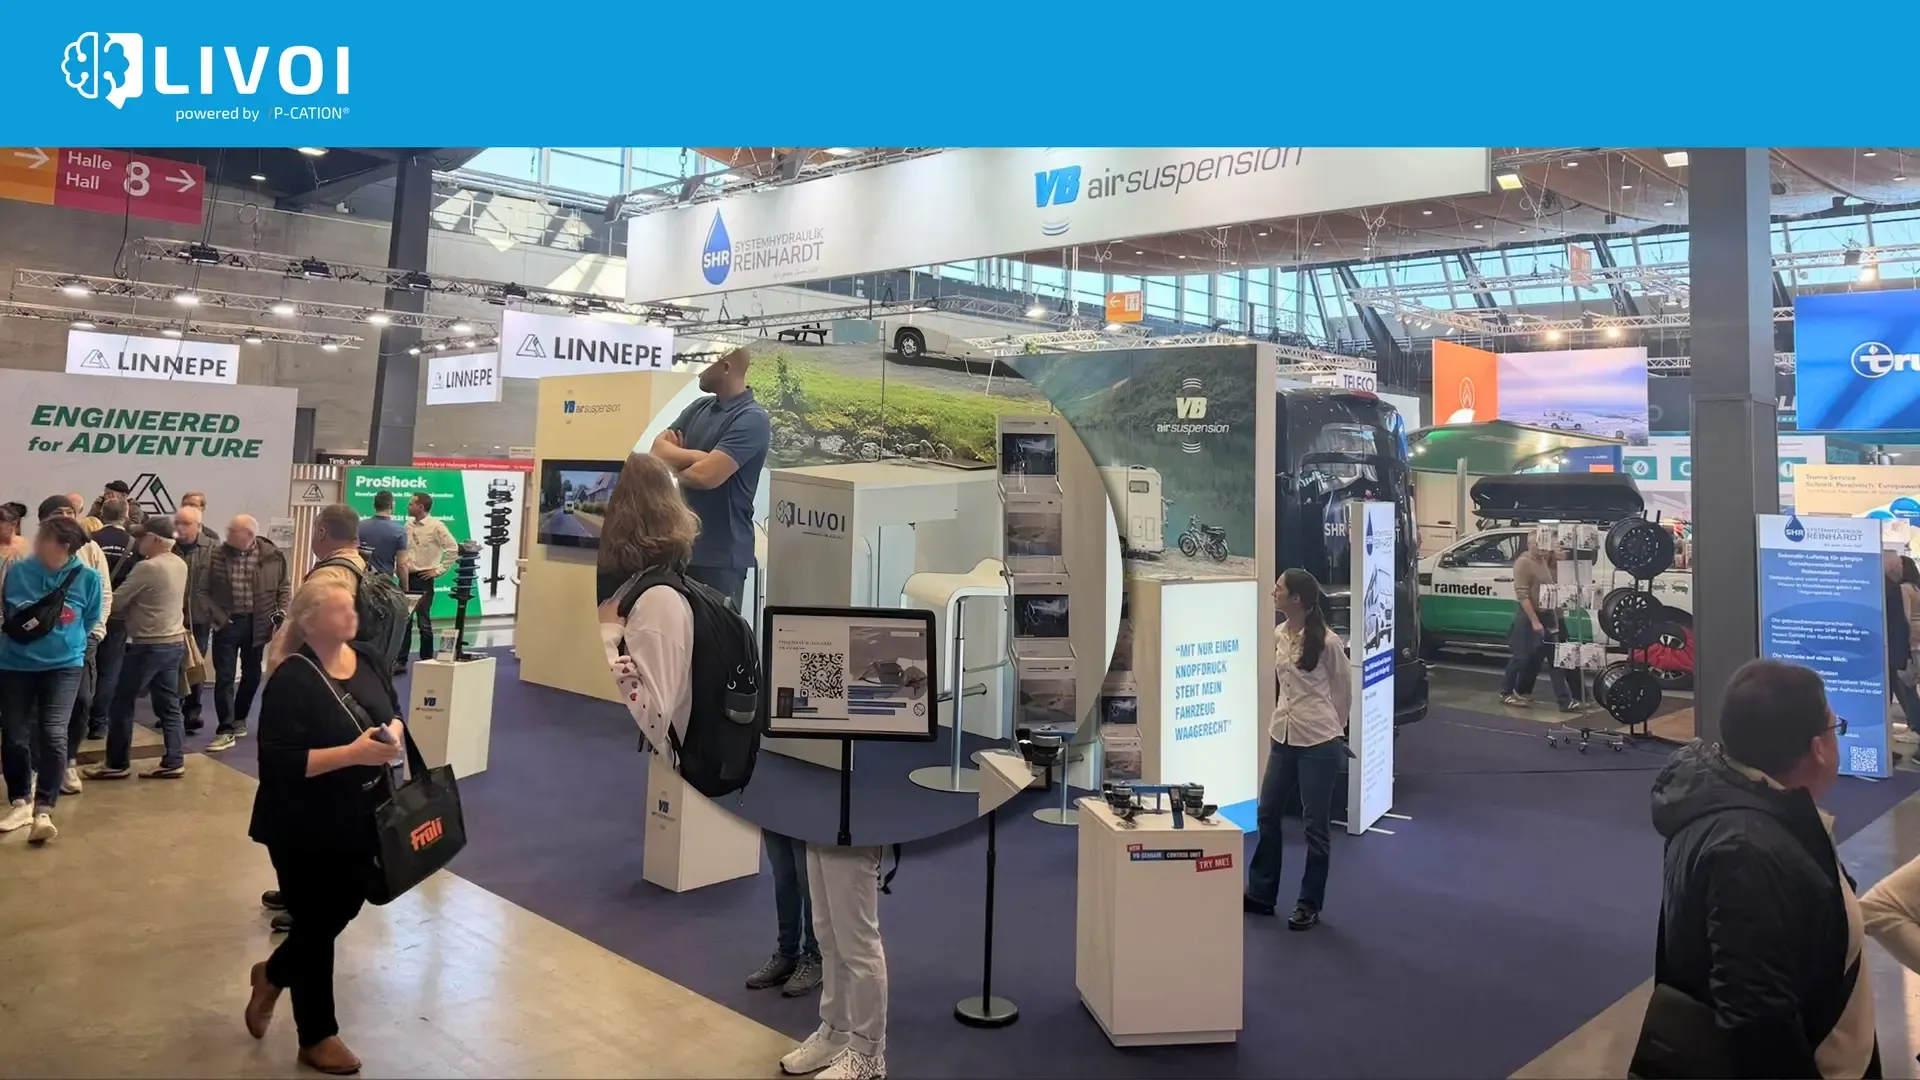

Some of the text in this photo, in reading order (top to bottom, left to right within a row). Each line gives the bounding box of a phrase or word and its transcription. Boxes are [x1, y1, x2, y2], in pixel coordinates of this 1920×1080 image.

[68, 151, 112, 170] Halle
[66, 172, 100, 190] Hall
[124, 161, 150, 197] 8
[1034, 165, 1082, 208] VB
[735, 227, 824, 253] SYSTEMHYDRAULIK
[703, 249, 730, 268] SHR
[733, 241, 824, 272] REINHARDT
[554, 336, 662, 368] LINNEPE
[118, 351, 227, 377] LINNEPE
[446, 368, 492, 389] LINNEPE
[564, 400, 576, 414] VB
[1176, 396, 1207, 419] VB
[31, 404, 240, 434] ENGINEERED
[1156, 421, 1230, 435] airsuspension
[28, 432, 263, 458] for ADVENTURE
[356, 475, 427, 489] ProShock
[797, 508, 845, 532] LIVOI
[1324, 523, 1346, 537] SHR
[1786, 528, 1804, 536] SHR
[1806, 532, 1863, 541] REINHARDT
[1197, 642, 1214, 656] NUR
[1215, 639, 1239, 654] EINEM
[1175, 660, 1227, 679] KNOPFDRUCK
[1175, 681, 1222, 700] STEHT MEIN
[424, 697, 436, 706] VB
[1175, 702, 1215, 720] FAHRZEUG
[1199, 857, 1230, 870] TRY ME!
